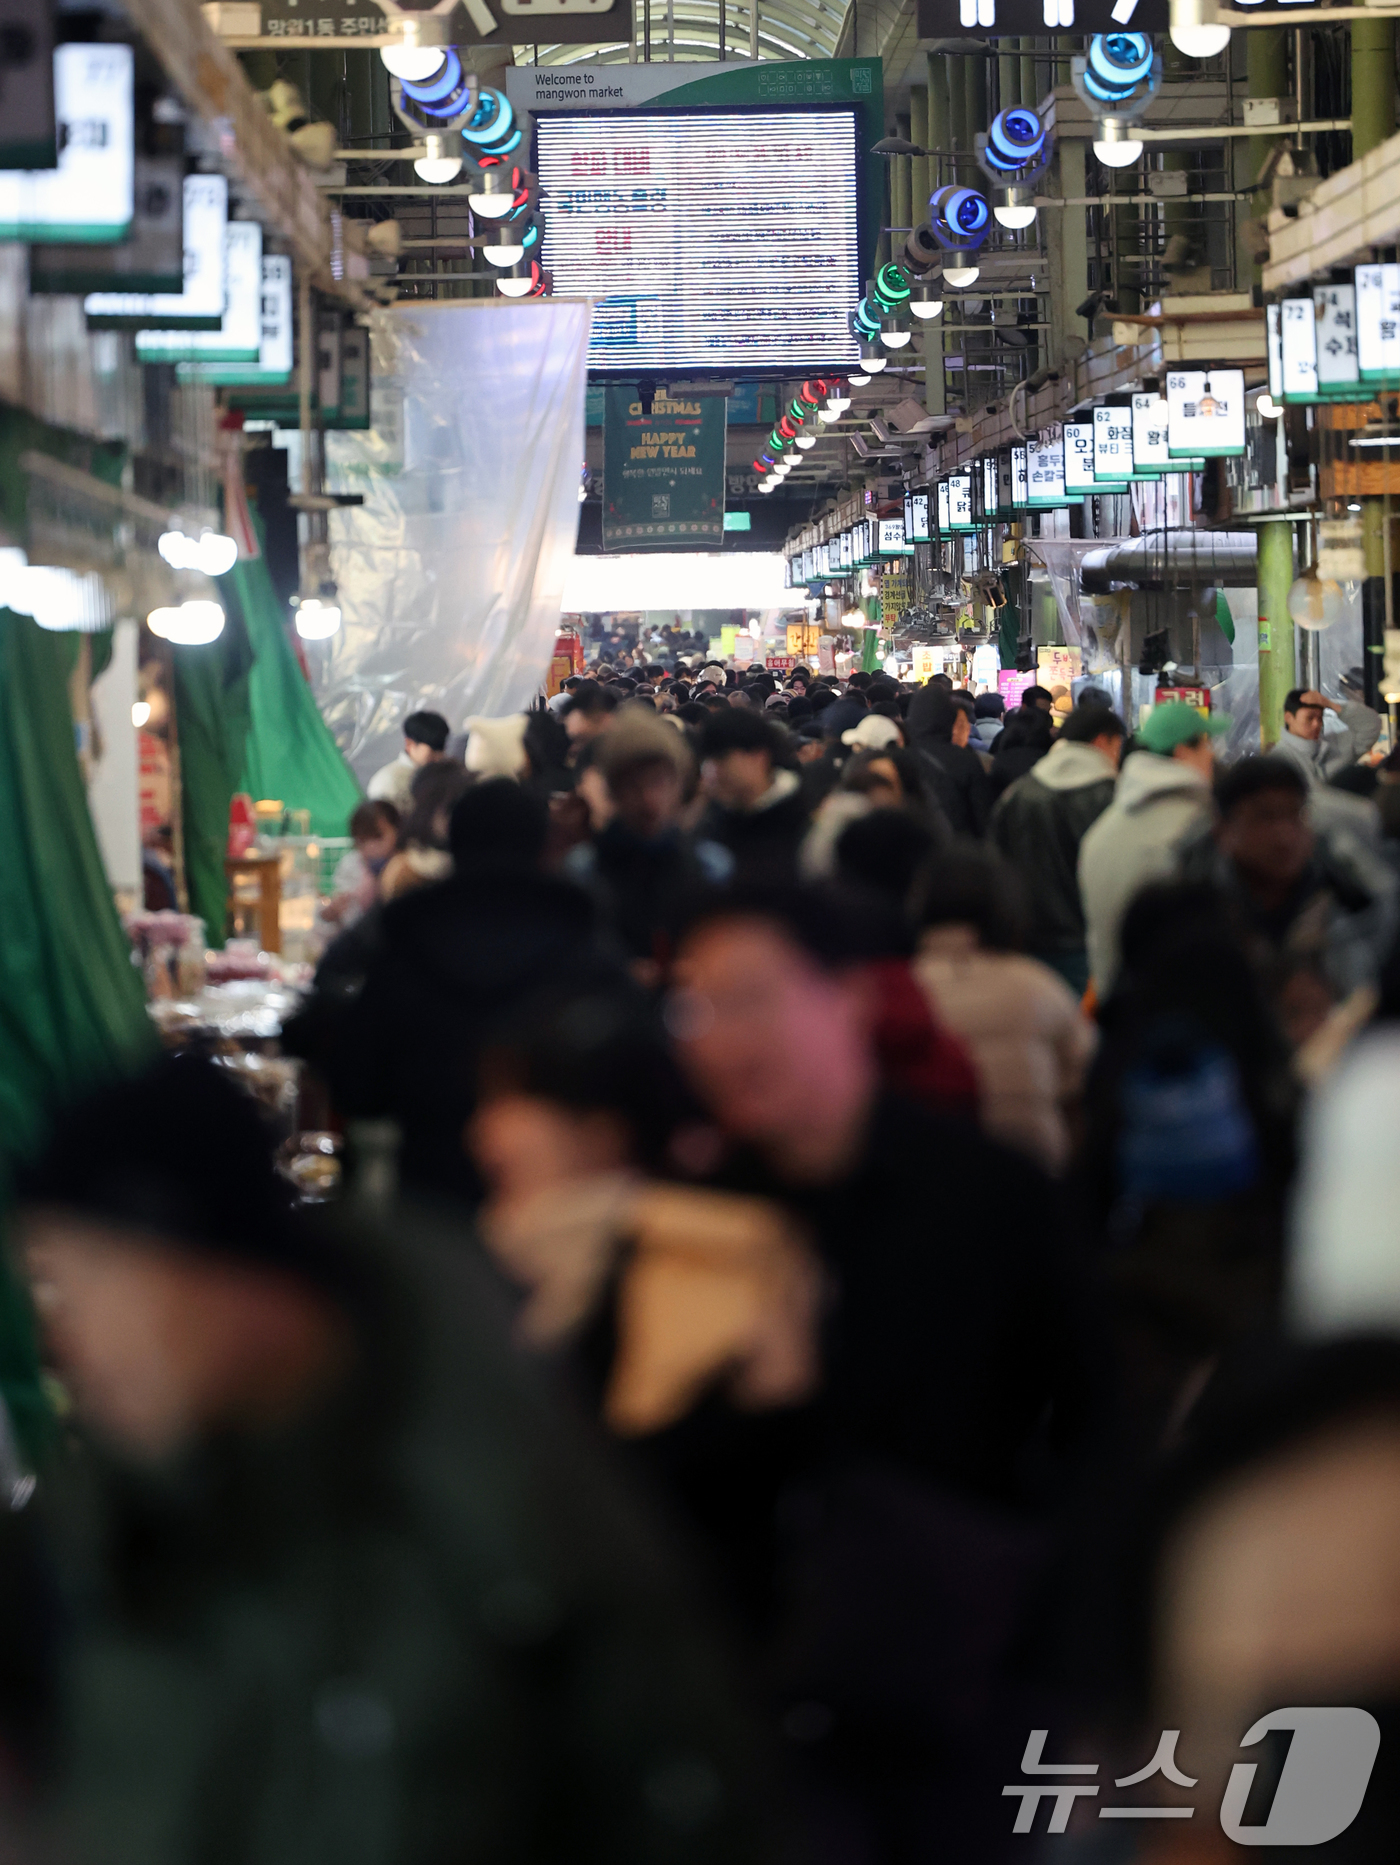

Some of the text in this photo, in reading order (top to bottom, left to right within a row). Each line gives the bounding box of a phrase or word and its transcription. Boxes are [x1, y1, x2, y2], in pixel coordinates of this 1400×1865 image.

[267, 18, 335, 37] 망원1동
[535, 74, 594, 85] Welcome to
[536, 86, 623, 101] mangwon market
[1284, 305, 1304, 320] 72
[1170, 377, 1186, 389] 66
[1135, 398, 1150, 409] 64
[1096, 412, 1111, 422] 62
[641, 432, 687, 446] HAPPY
[1066, 428, 1080, 438] 60
[630, 445, 697, 460] NEW YEAR
[1075, 439, 1094, 454] 오
[1037, 455, 1064, 468] 홍두
[950, 480, 961, 488] 48
[914, 498, 924, 506] 42
